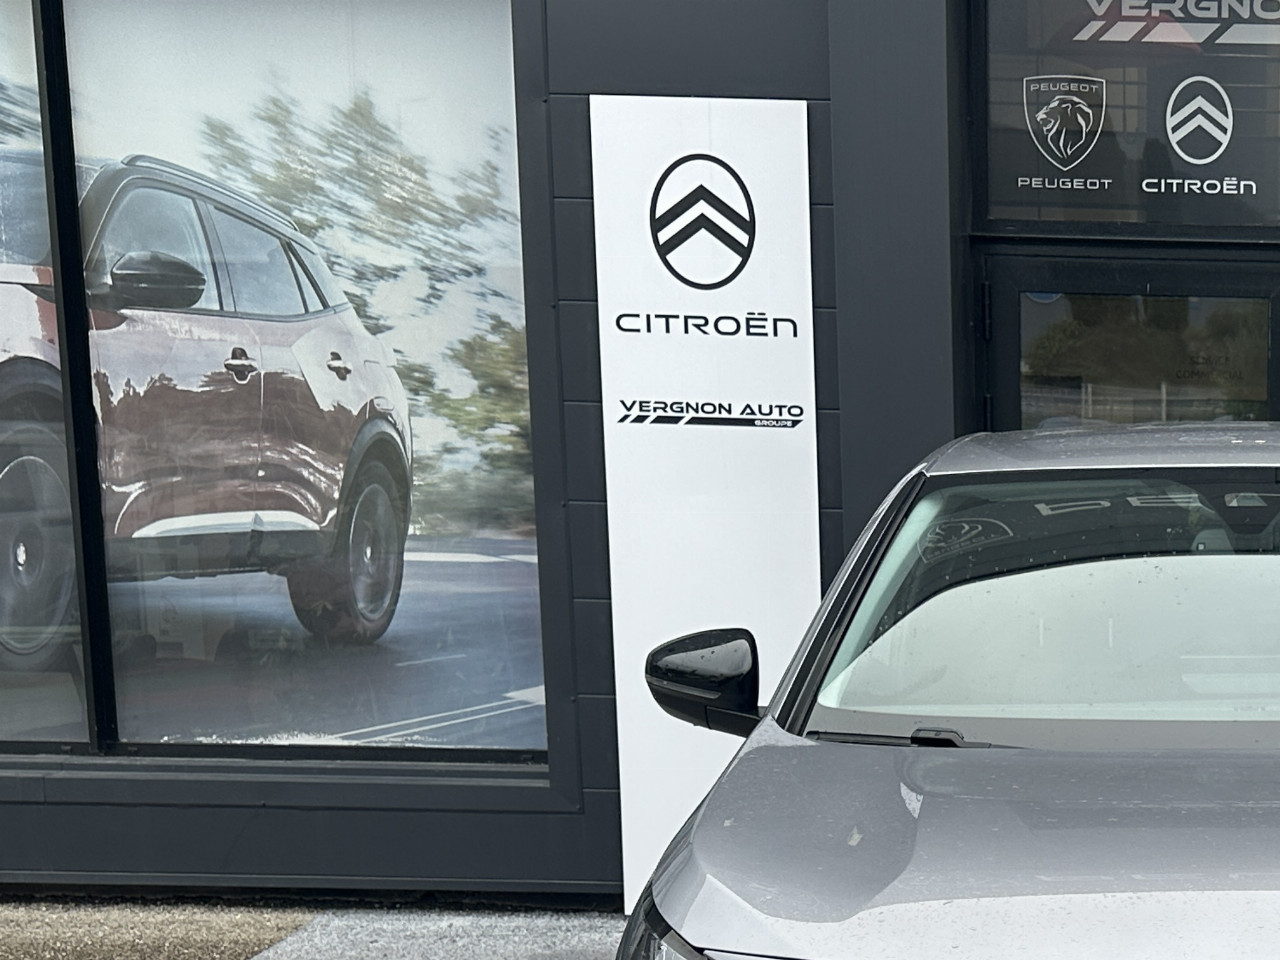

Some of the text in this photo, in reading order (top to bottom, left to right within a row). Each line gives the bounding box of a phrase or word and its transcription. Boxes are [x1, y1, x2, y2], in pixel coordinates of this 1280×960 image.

[1030, 82, 1099, 93] PEUGEOT
[1017, 177, 1113, 190] PEUGEOT
[619, 400, 805, 418] VERGNON AUTO
[754, 419, 793, 427] GROUPE
